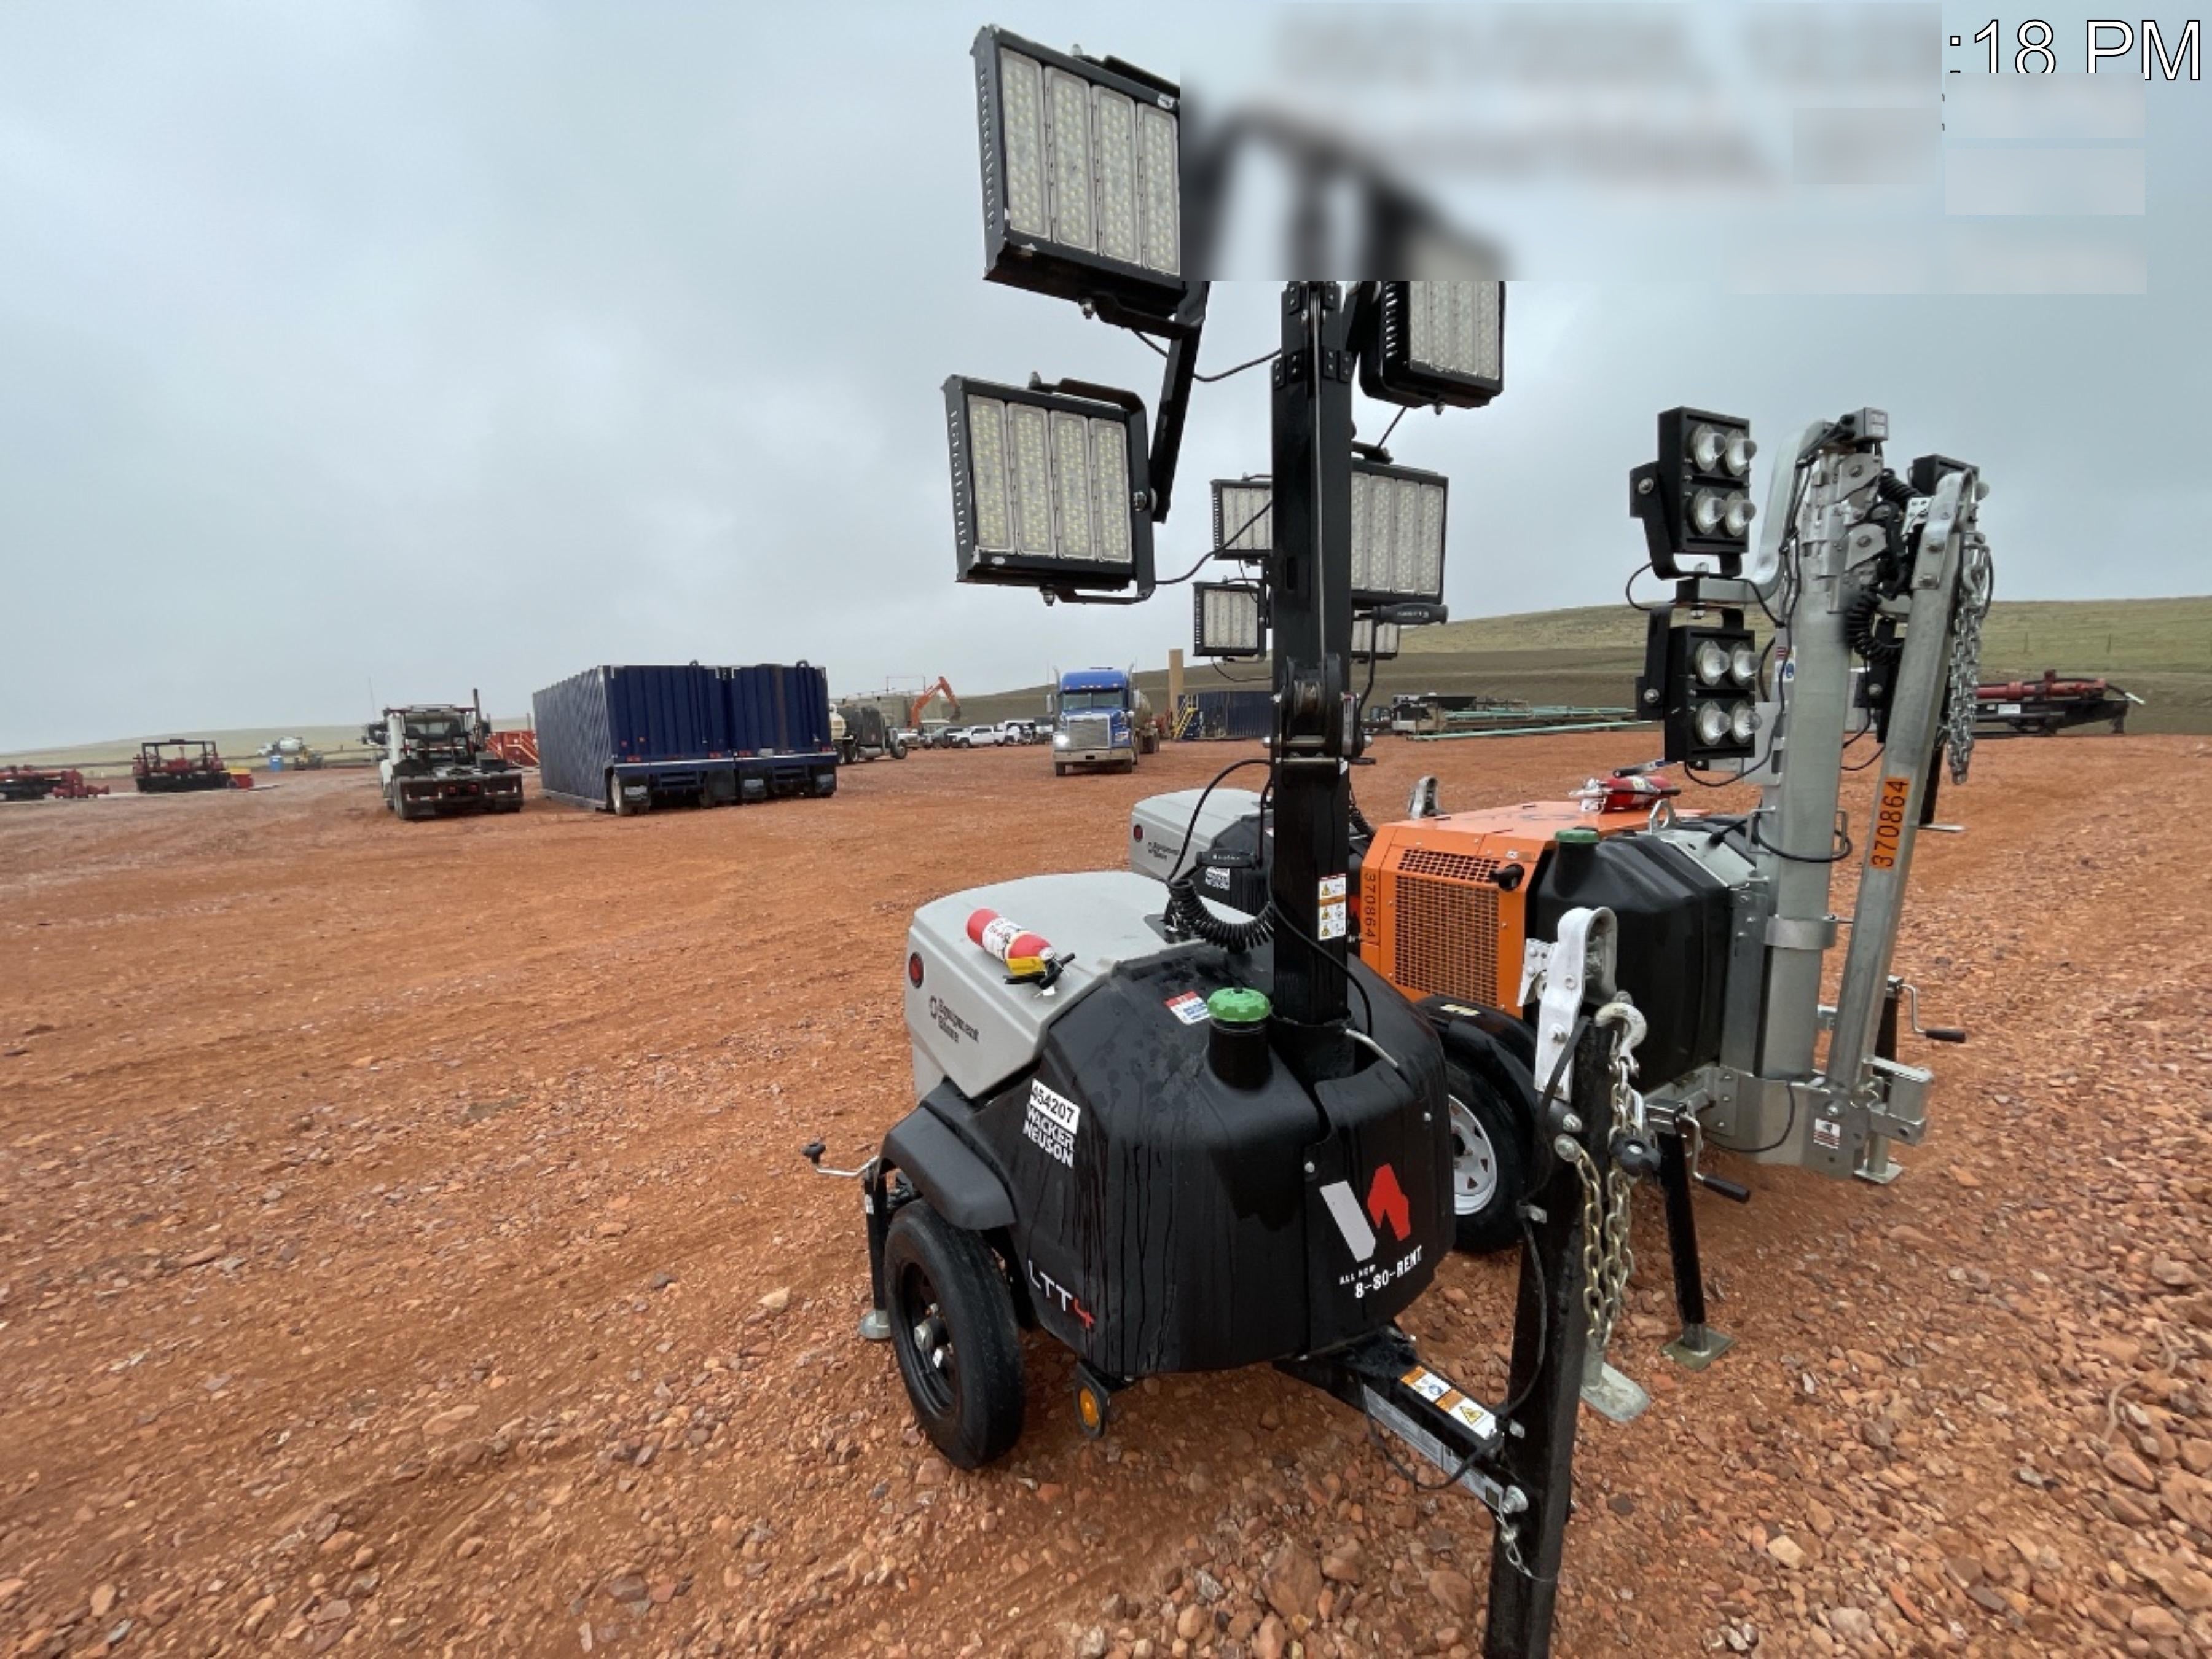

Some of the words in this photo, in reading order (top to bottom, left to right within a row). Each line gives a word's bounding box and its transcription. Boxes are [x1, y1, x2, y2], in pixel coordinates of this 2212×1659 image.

[1871, 780, 1908, 866] 370864
[1365, 872, 1376, 937] 370864
[1027, 1103, 1075, 1152] WACKER
[1032, 1085, 1075, 1124] 454207
[1022, 1119, 1074, 1168] NEUSON
[1028, 1260, 1094, 1329] LTT4
